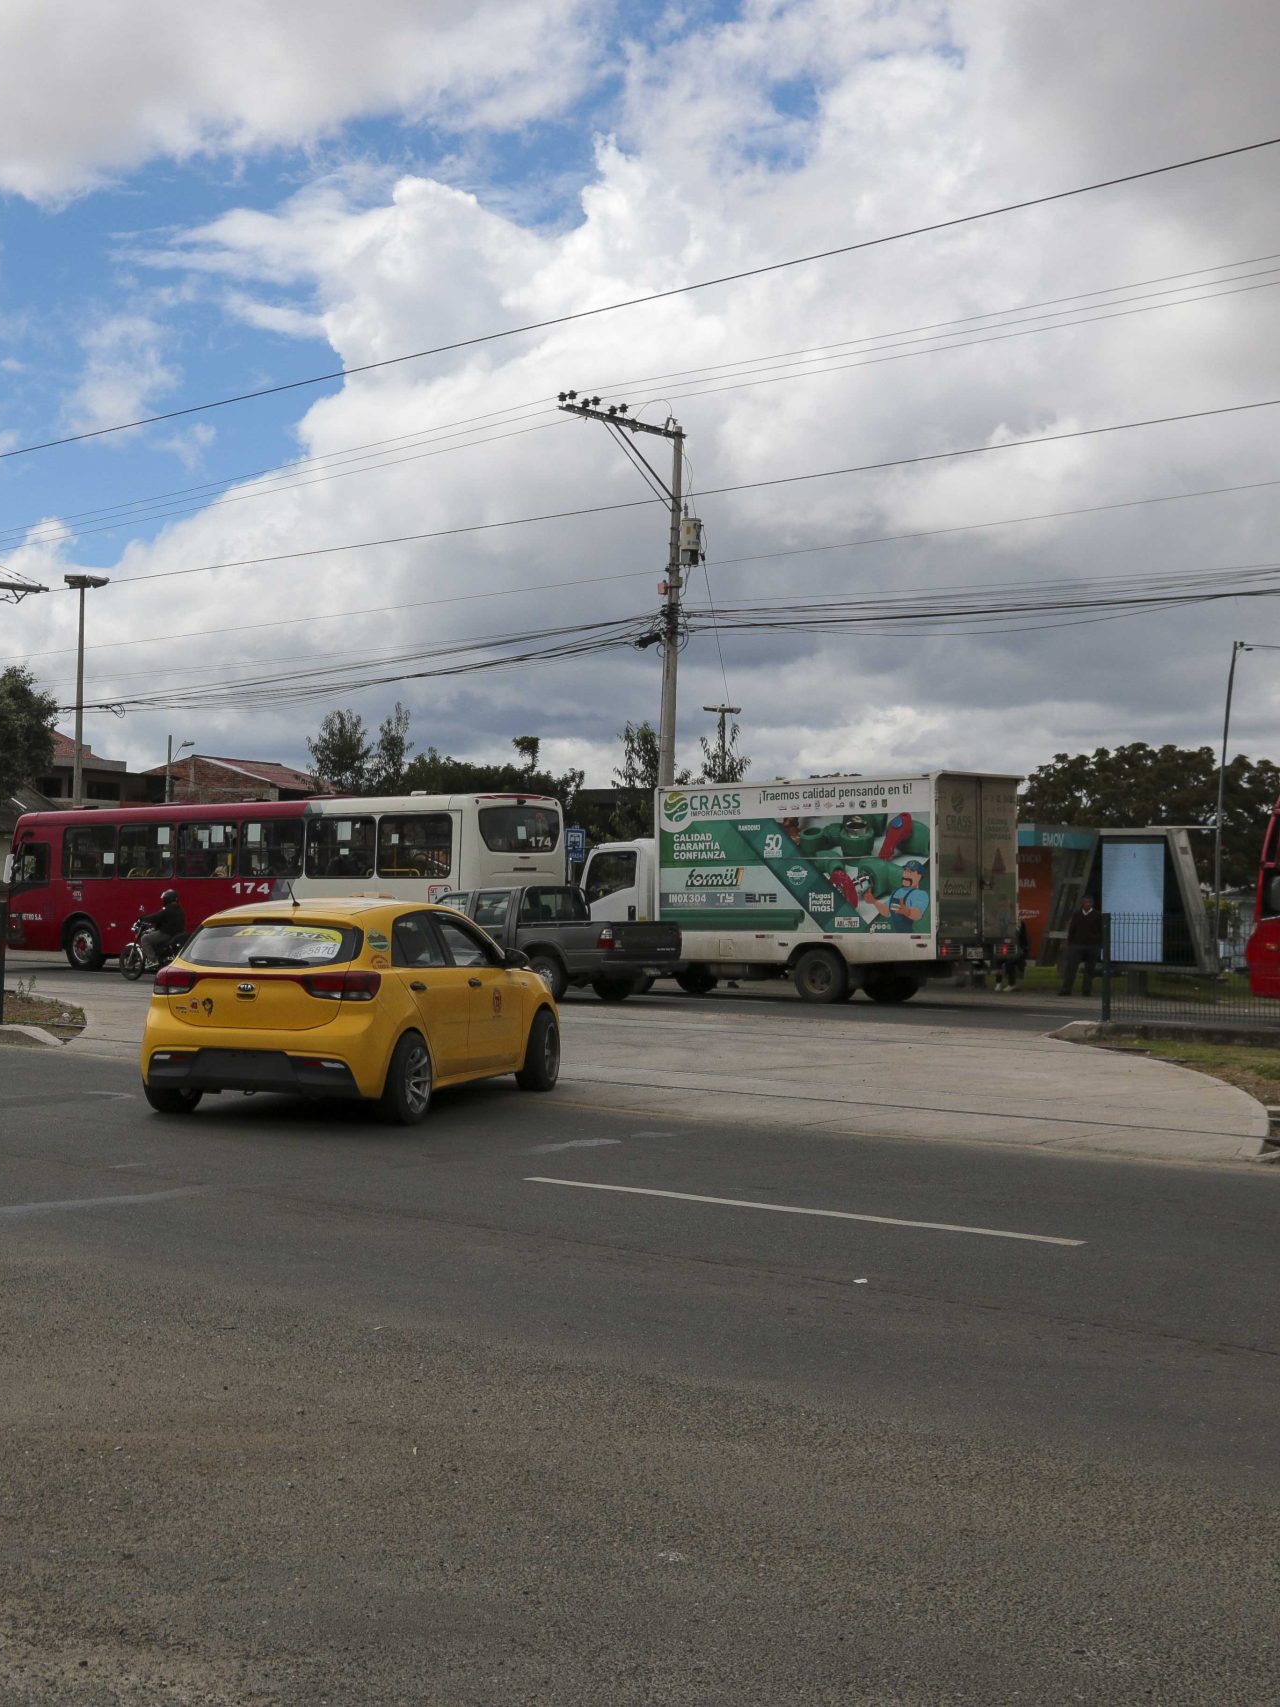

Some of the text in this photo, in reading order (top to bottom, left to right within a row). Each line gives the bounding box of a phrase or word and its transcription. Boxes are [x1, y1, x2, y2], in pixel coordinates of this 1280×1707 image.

[759, 783, 913, 804] ¡Traemos calidad pensando en ti!
[689, 793, 741, 810] CRASS
[690, 808, 741, 817] IMPORTACIONES
[529, 836, 552, 848] 174
[673, 833, 713, 842] CALIDAD
[764, 834, 782, 850] 50
[1042, 832, 1065, 847] EMOV
[673, 841, 721, 851] GARANTÍA
[673, 851, 726, 860] CONFIANZA
[231, 882, 270, 895] 174
